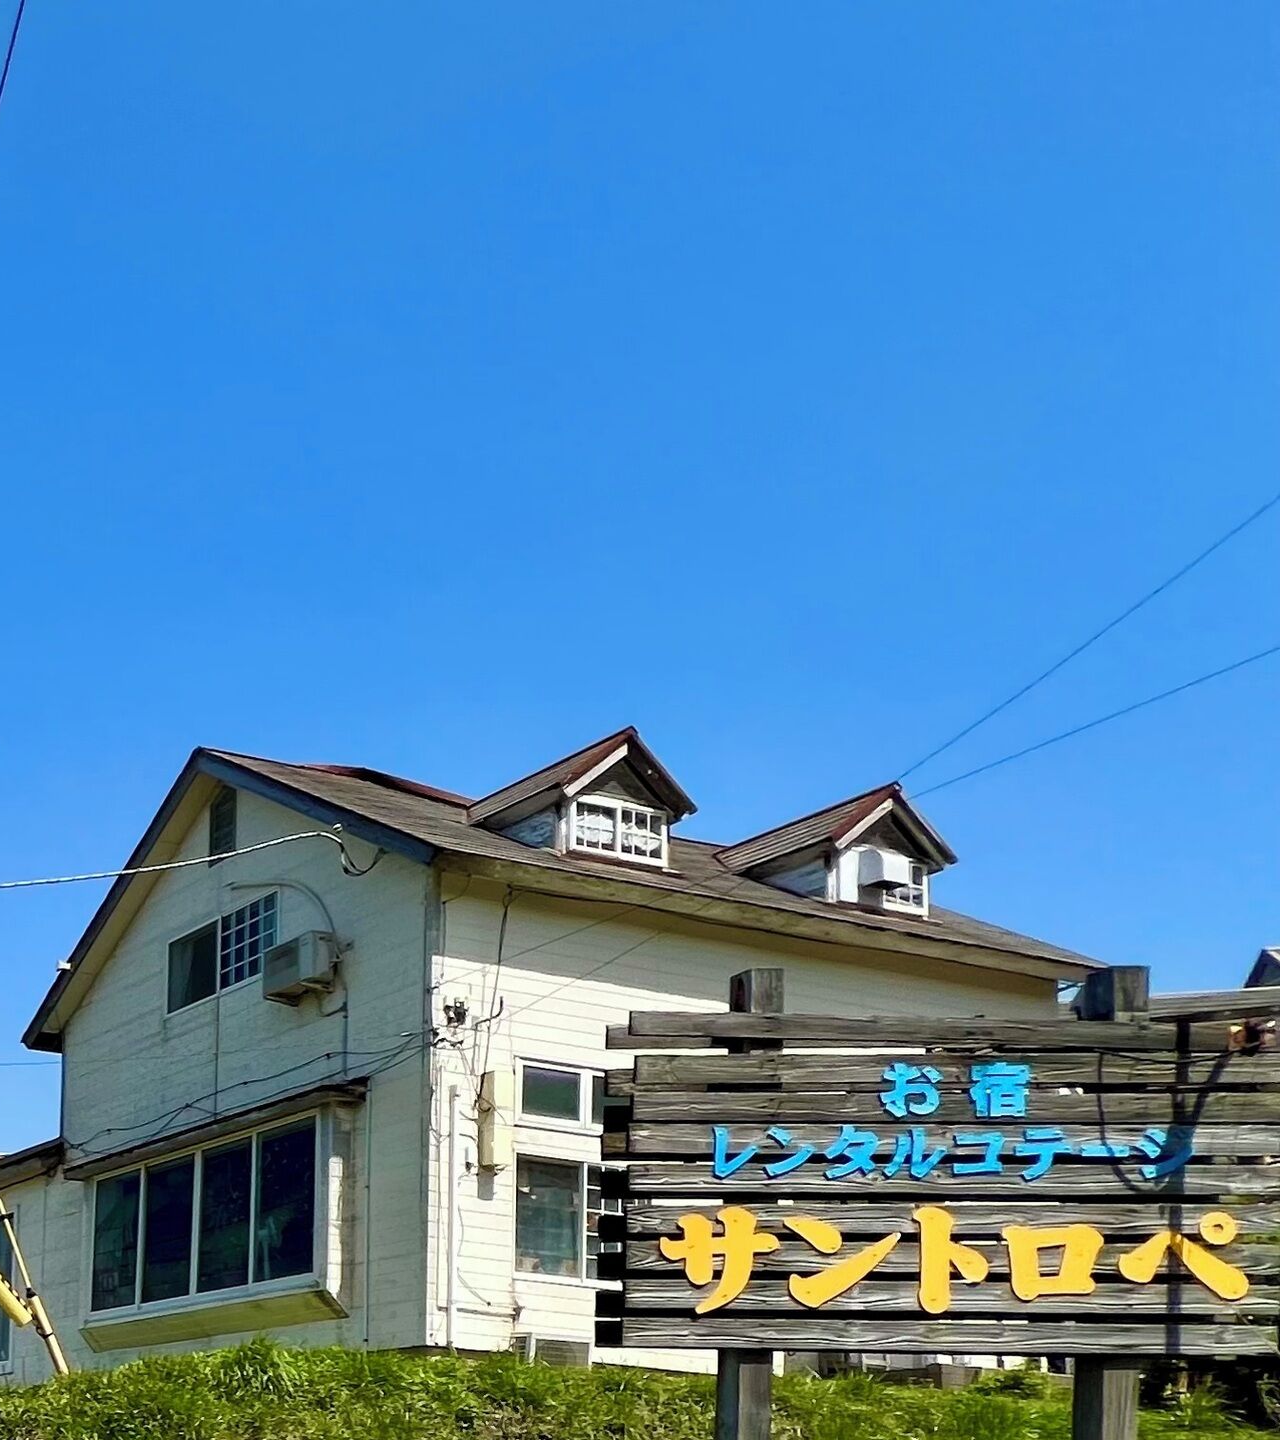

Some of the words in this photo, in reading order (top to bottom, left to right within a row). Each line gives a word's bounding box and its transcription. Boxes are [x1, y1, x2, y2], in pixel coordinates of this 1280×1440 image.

[880, 1060, 1033, 1118] お宿
[659, 1204, 1251, 1315] サントロペ
